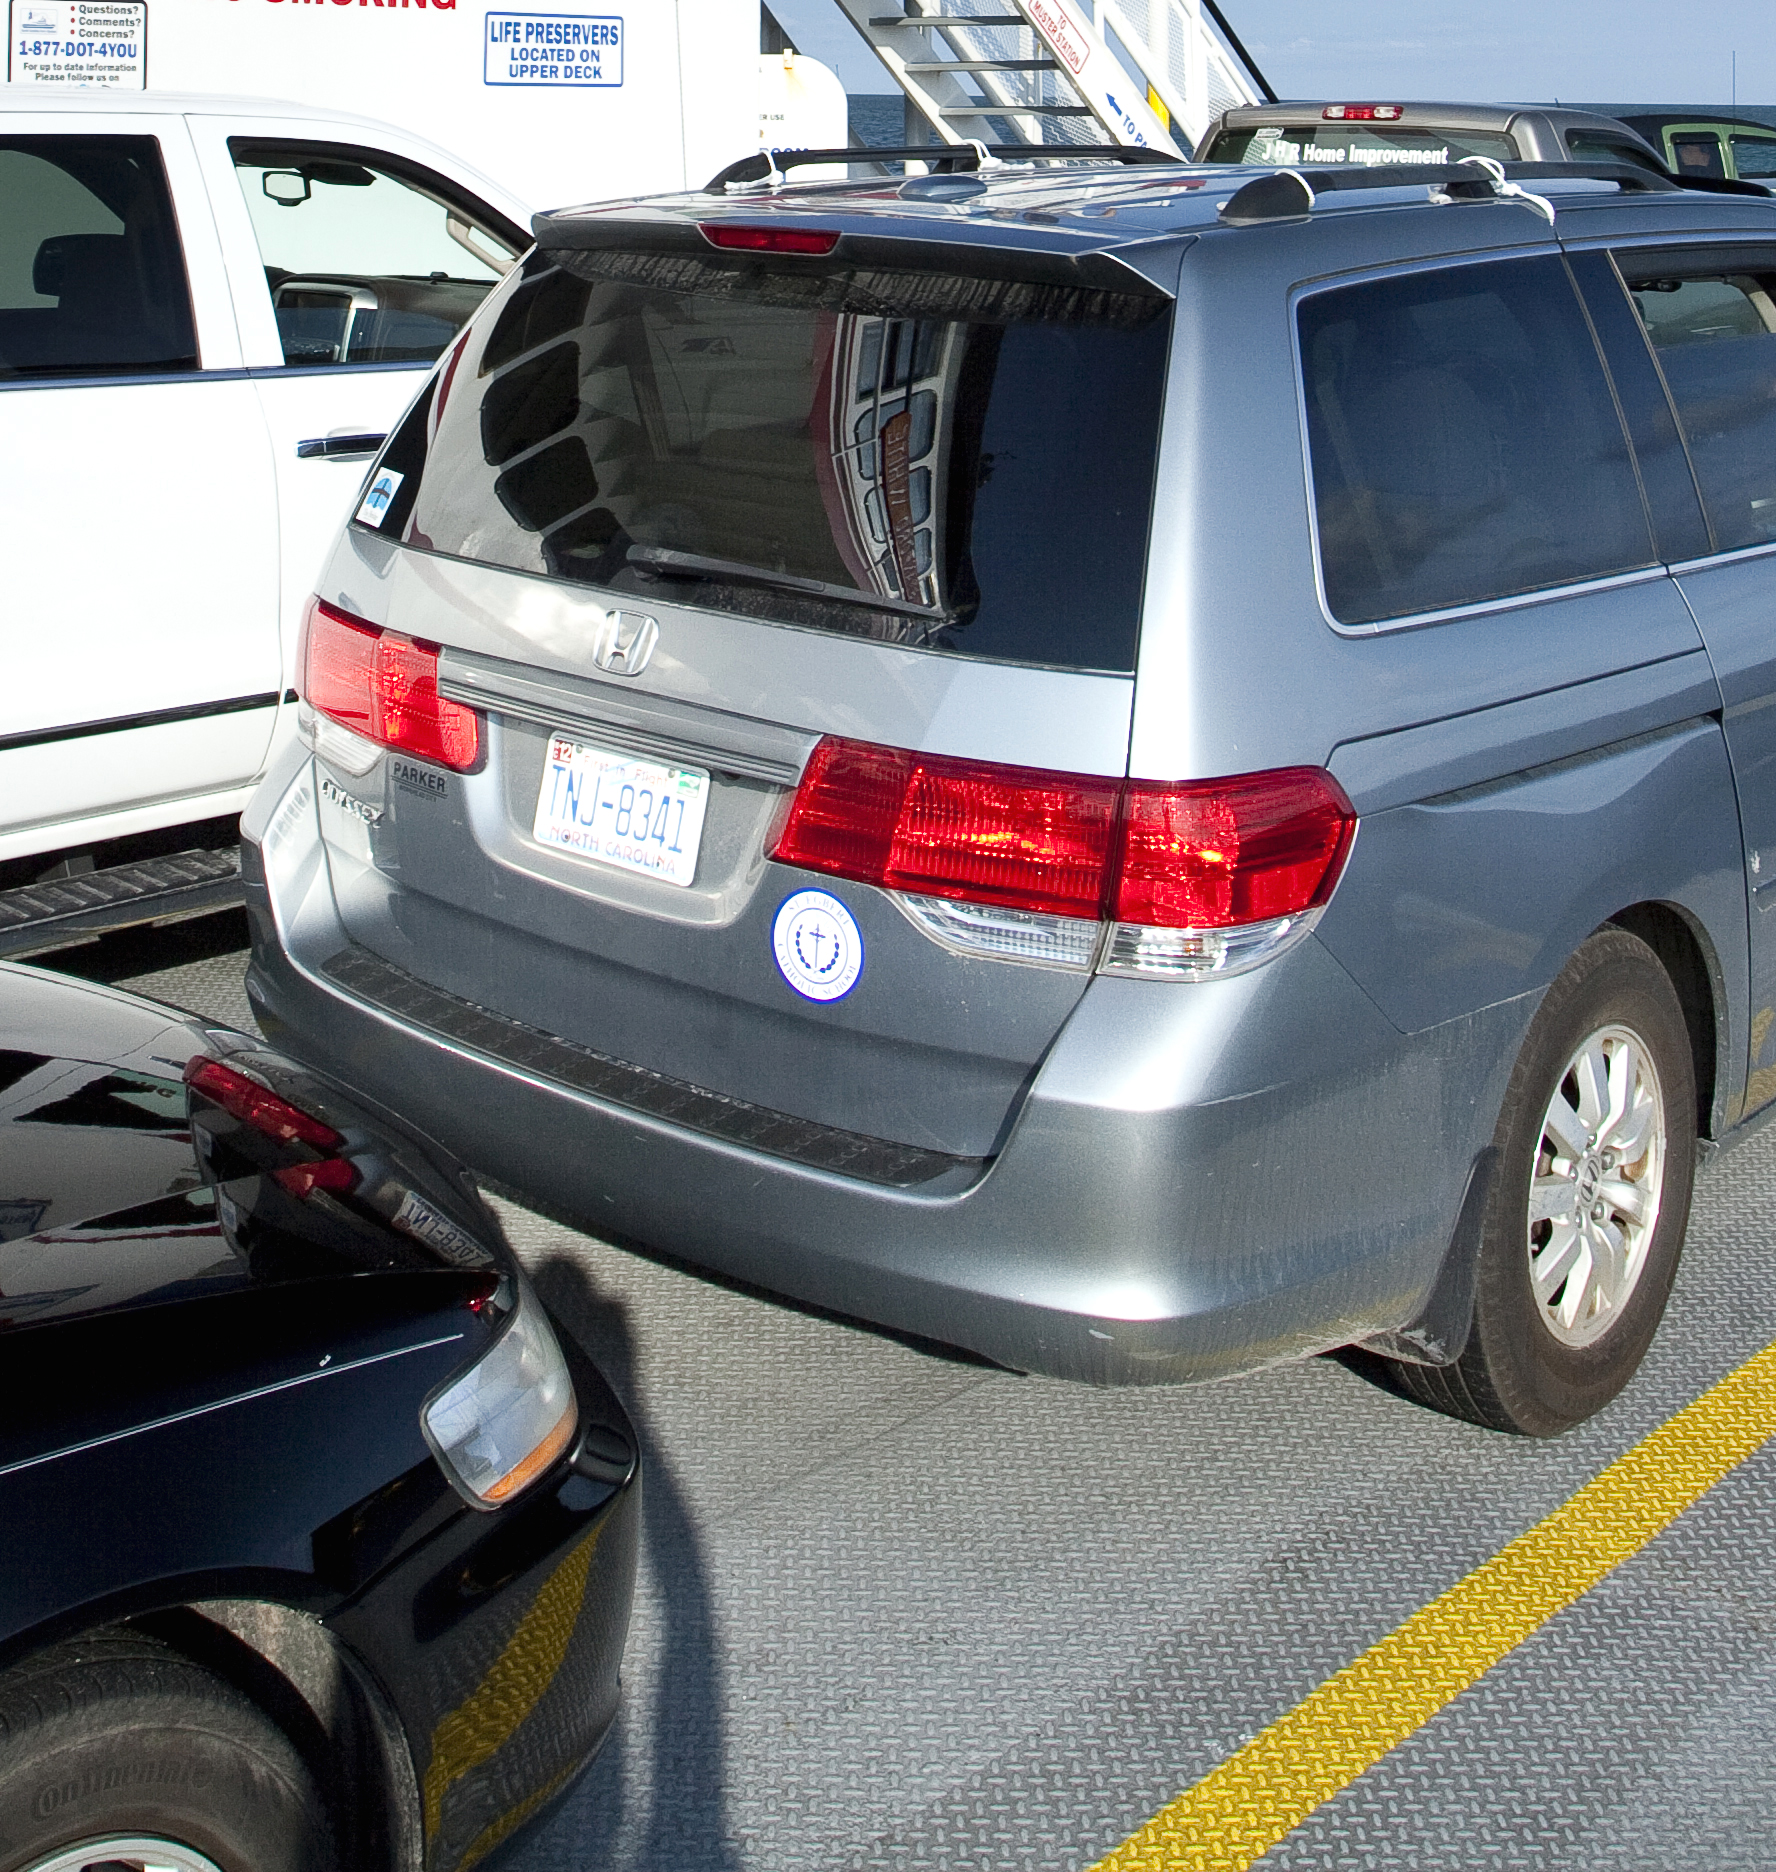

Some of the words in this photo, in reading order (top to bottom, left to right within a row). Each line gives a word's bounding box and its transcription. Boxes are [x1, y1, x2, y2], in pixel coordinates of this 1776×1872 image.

[79, 4, 139, 15] Questions?
[79, 16, 141, 26] Comments?
[1057, 14, 1067, 30] TO
[79, 29, 135, 38] Concerns?
[491, 21, 521, 43] LIFE
[526, 22, 618, 46] PRESERVERS
[1033, 0, 1057, 37] MUSTER
[1056, 32, 1081, 68] STATION
[19, 40, 137, 58] 1-877-DOT-4YOU
[510, 47, 575, 62] LOCATED
[580, 49, 600, 63] ON
[23, 62, 38, 71] For
[40, 64, 51, 72] up
[53, 63, 62, 71] to
[64, 63, 84, 71] date
[509, 64, 559, 79] UPPER
[564, 65, 602, 79] DECK
[35, 72, 65, 81] Please
[68, 73, 94, 81] follow
[1123, 114, 1136, 135] TO
[1261, 142, 1272, 161] J
[1275, 140, 1287, 158] H
[1289, 142, 1300, 161] R
[1303, 143, 1345, 163] Home
[1349, 144, 1449, 167] Improvement
[393, 761, 447, 793] PARKER
[549, 763, 686, 854] TNJ-8341
[549, 825, 600, 853] NORTH
[605, 841, 676, 875] CAROLINA
